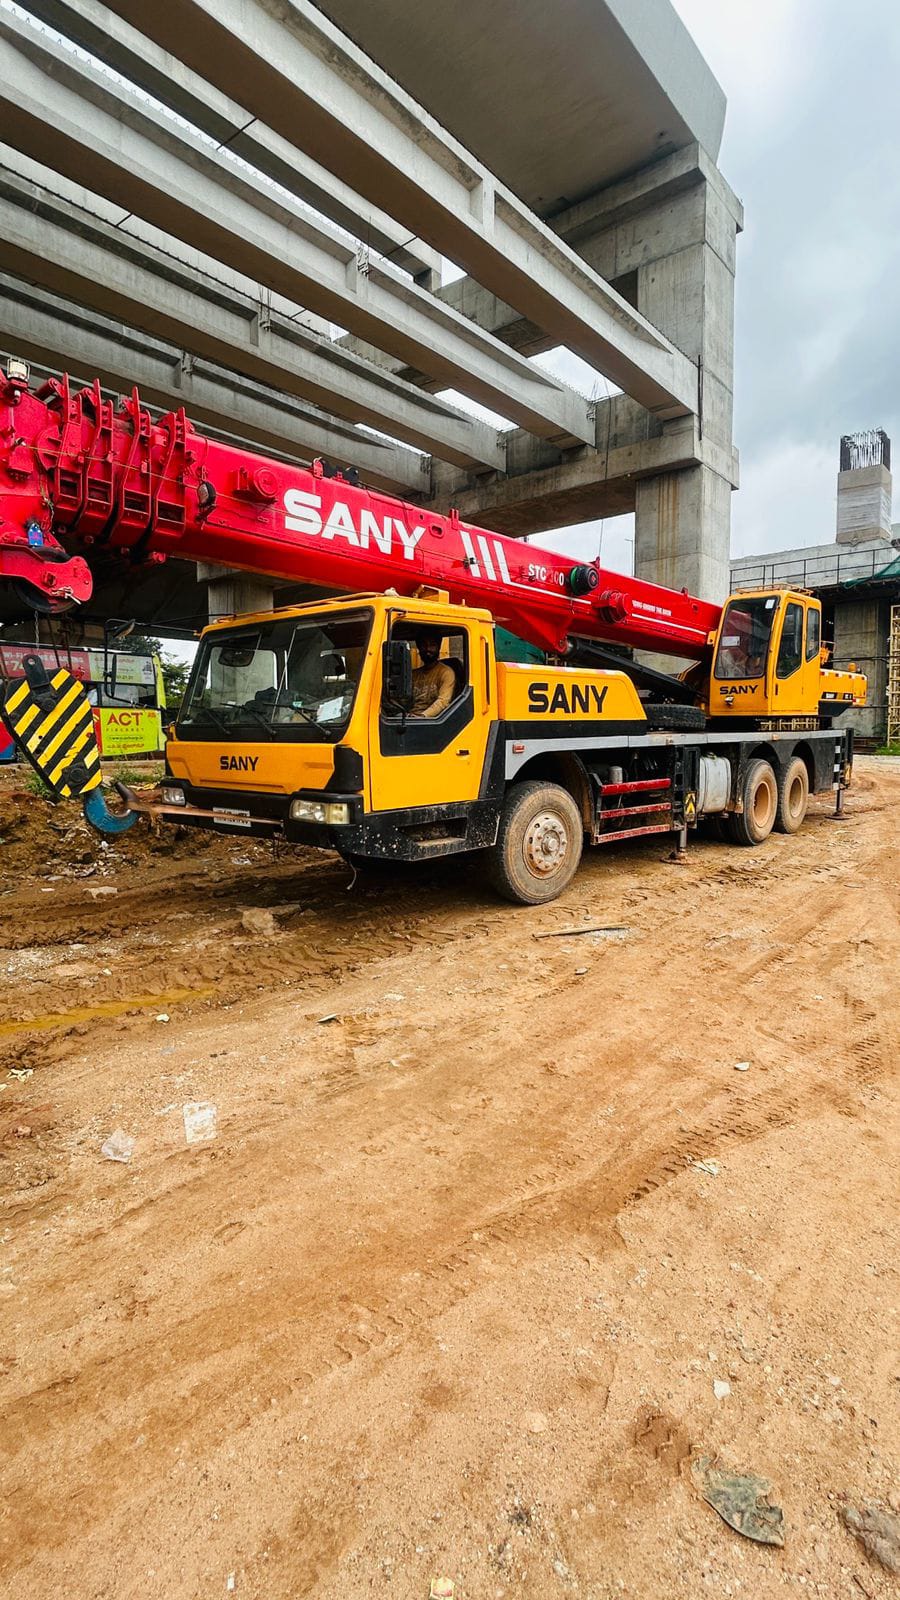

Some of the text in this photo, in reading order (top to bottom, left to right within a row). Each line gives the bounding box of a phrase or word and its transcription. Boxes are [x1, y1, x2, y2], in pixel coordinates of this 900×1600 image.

[283, 488, 427, 561] SANY
[528, 563, 547, 581] STC
[528, 682, 609, 714] SANY
[719, 684, 759, 695] SANY
[106, 711, 144, 726] ACT
[219, 755, 259, 772] SANY
